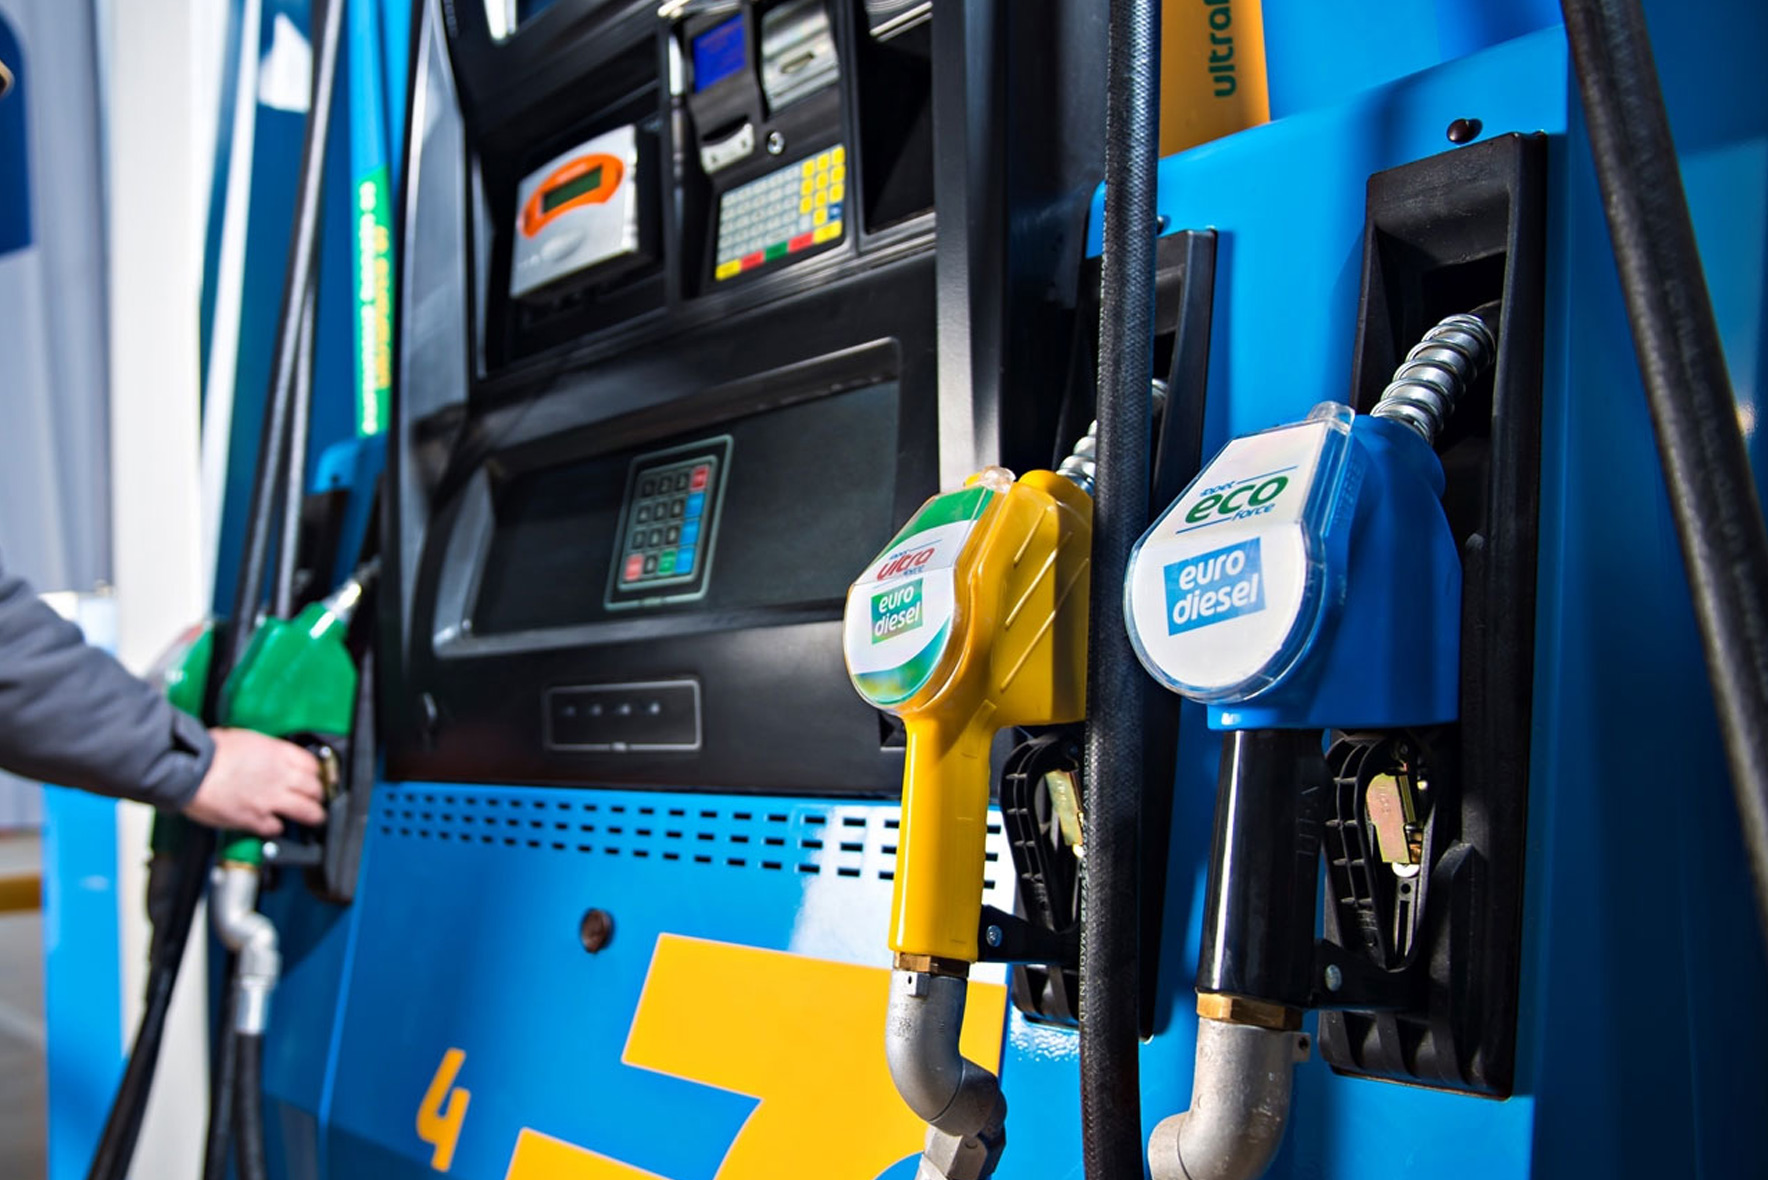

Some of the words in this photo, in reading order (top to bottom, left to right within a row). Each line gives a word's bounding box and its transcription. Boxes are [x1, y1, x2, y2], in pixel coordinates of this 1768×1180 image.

[1185, 476, 1289, 523] eco
[1231, 503, 1276, 521] force
[877, 548, 935, 581] ultra
[1178, 550, 1246, 590] euro
[878, 586, 915, 613] euro
[1172, 573, 1259, 625] diesel
[874, 601, 921, 636] diesel
[416, 1047, 471, 1173] 4
